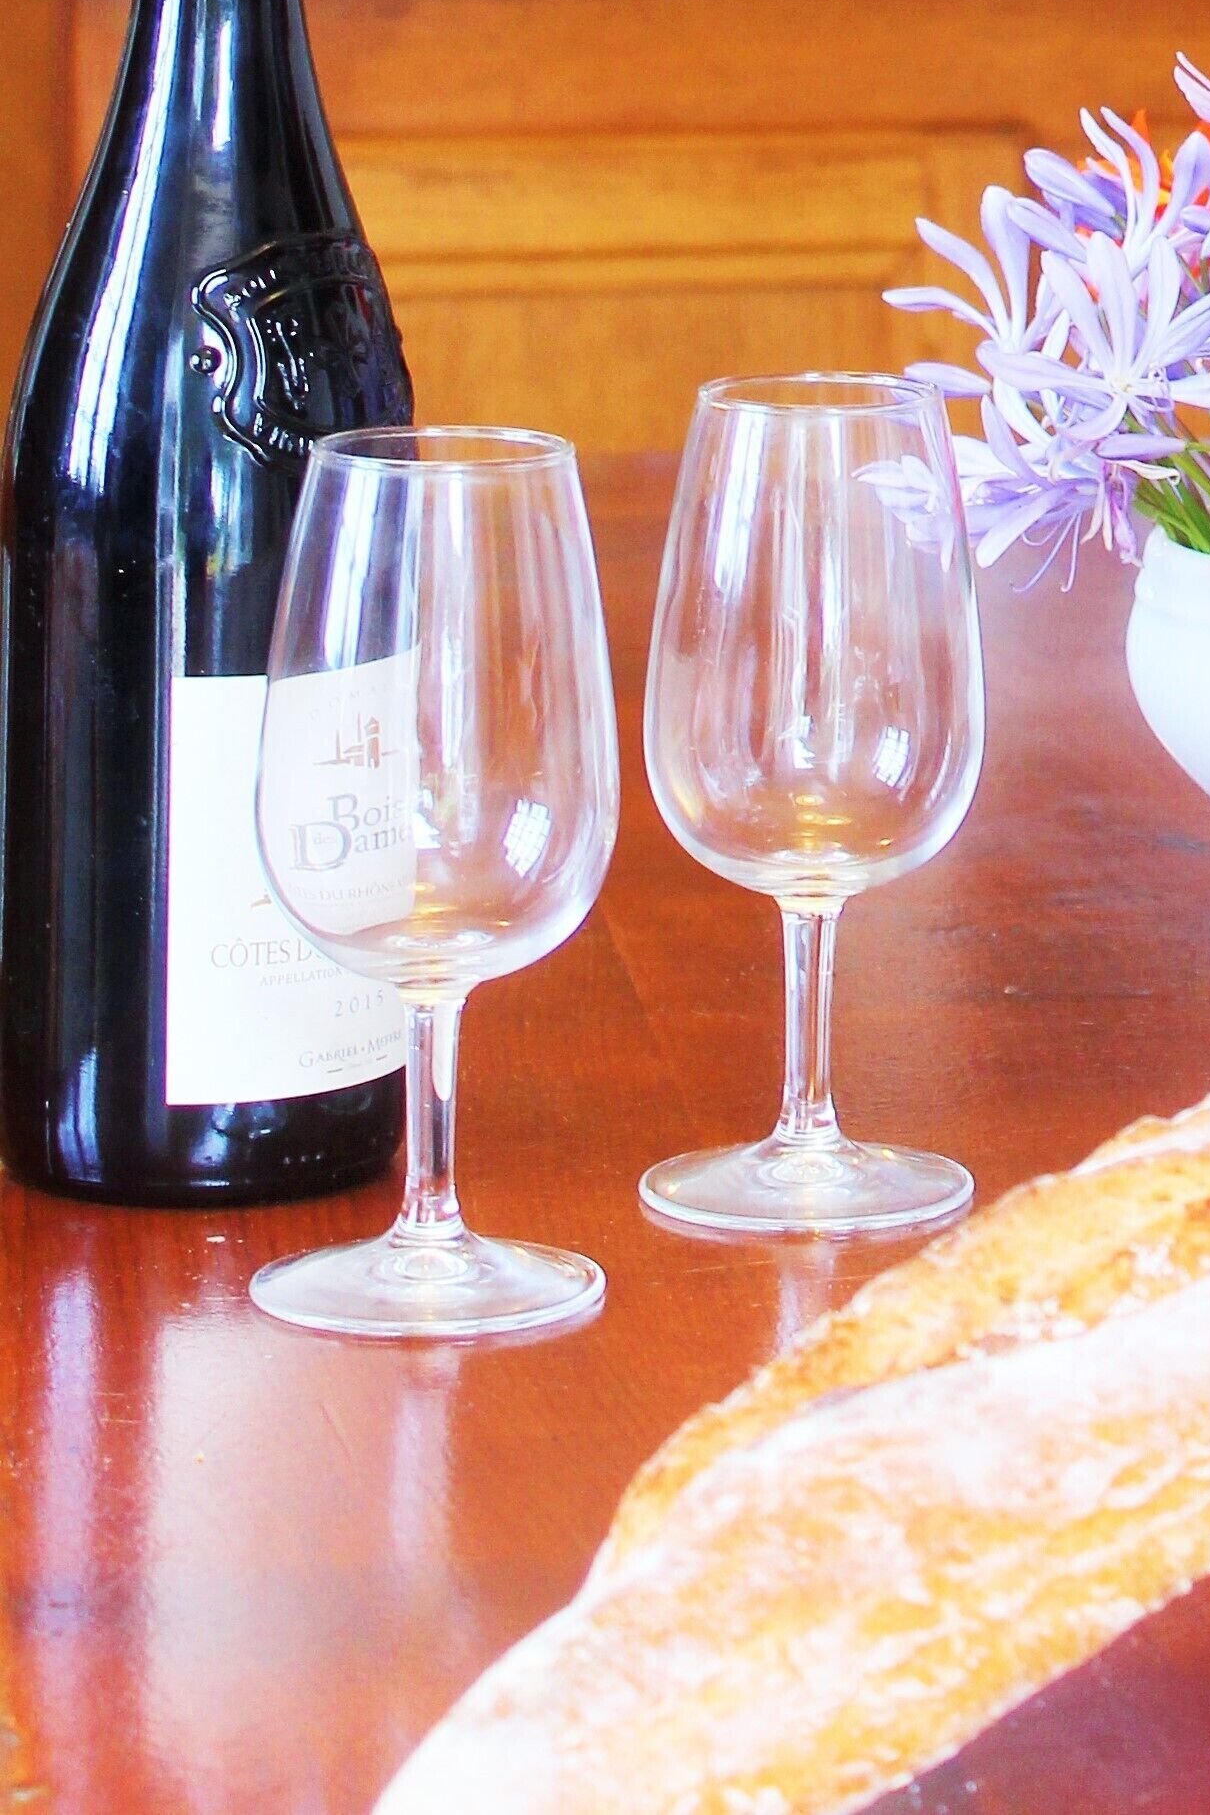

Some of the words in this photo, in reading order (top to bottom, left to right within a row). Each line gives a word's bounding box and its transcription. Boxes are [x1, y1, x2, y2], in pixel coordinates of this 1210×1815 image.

[326, 793, 405, 831] Bois
[288, 821, 409, 872] Dame
[210, 937, 291, 969] CÔTES
[260, 966, 343, 987] APPELLATION
[334, 989, 385, 1018] 2015
